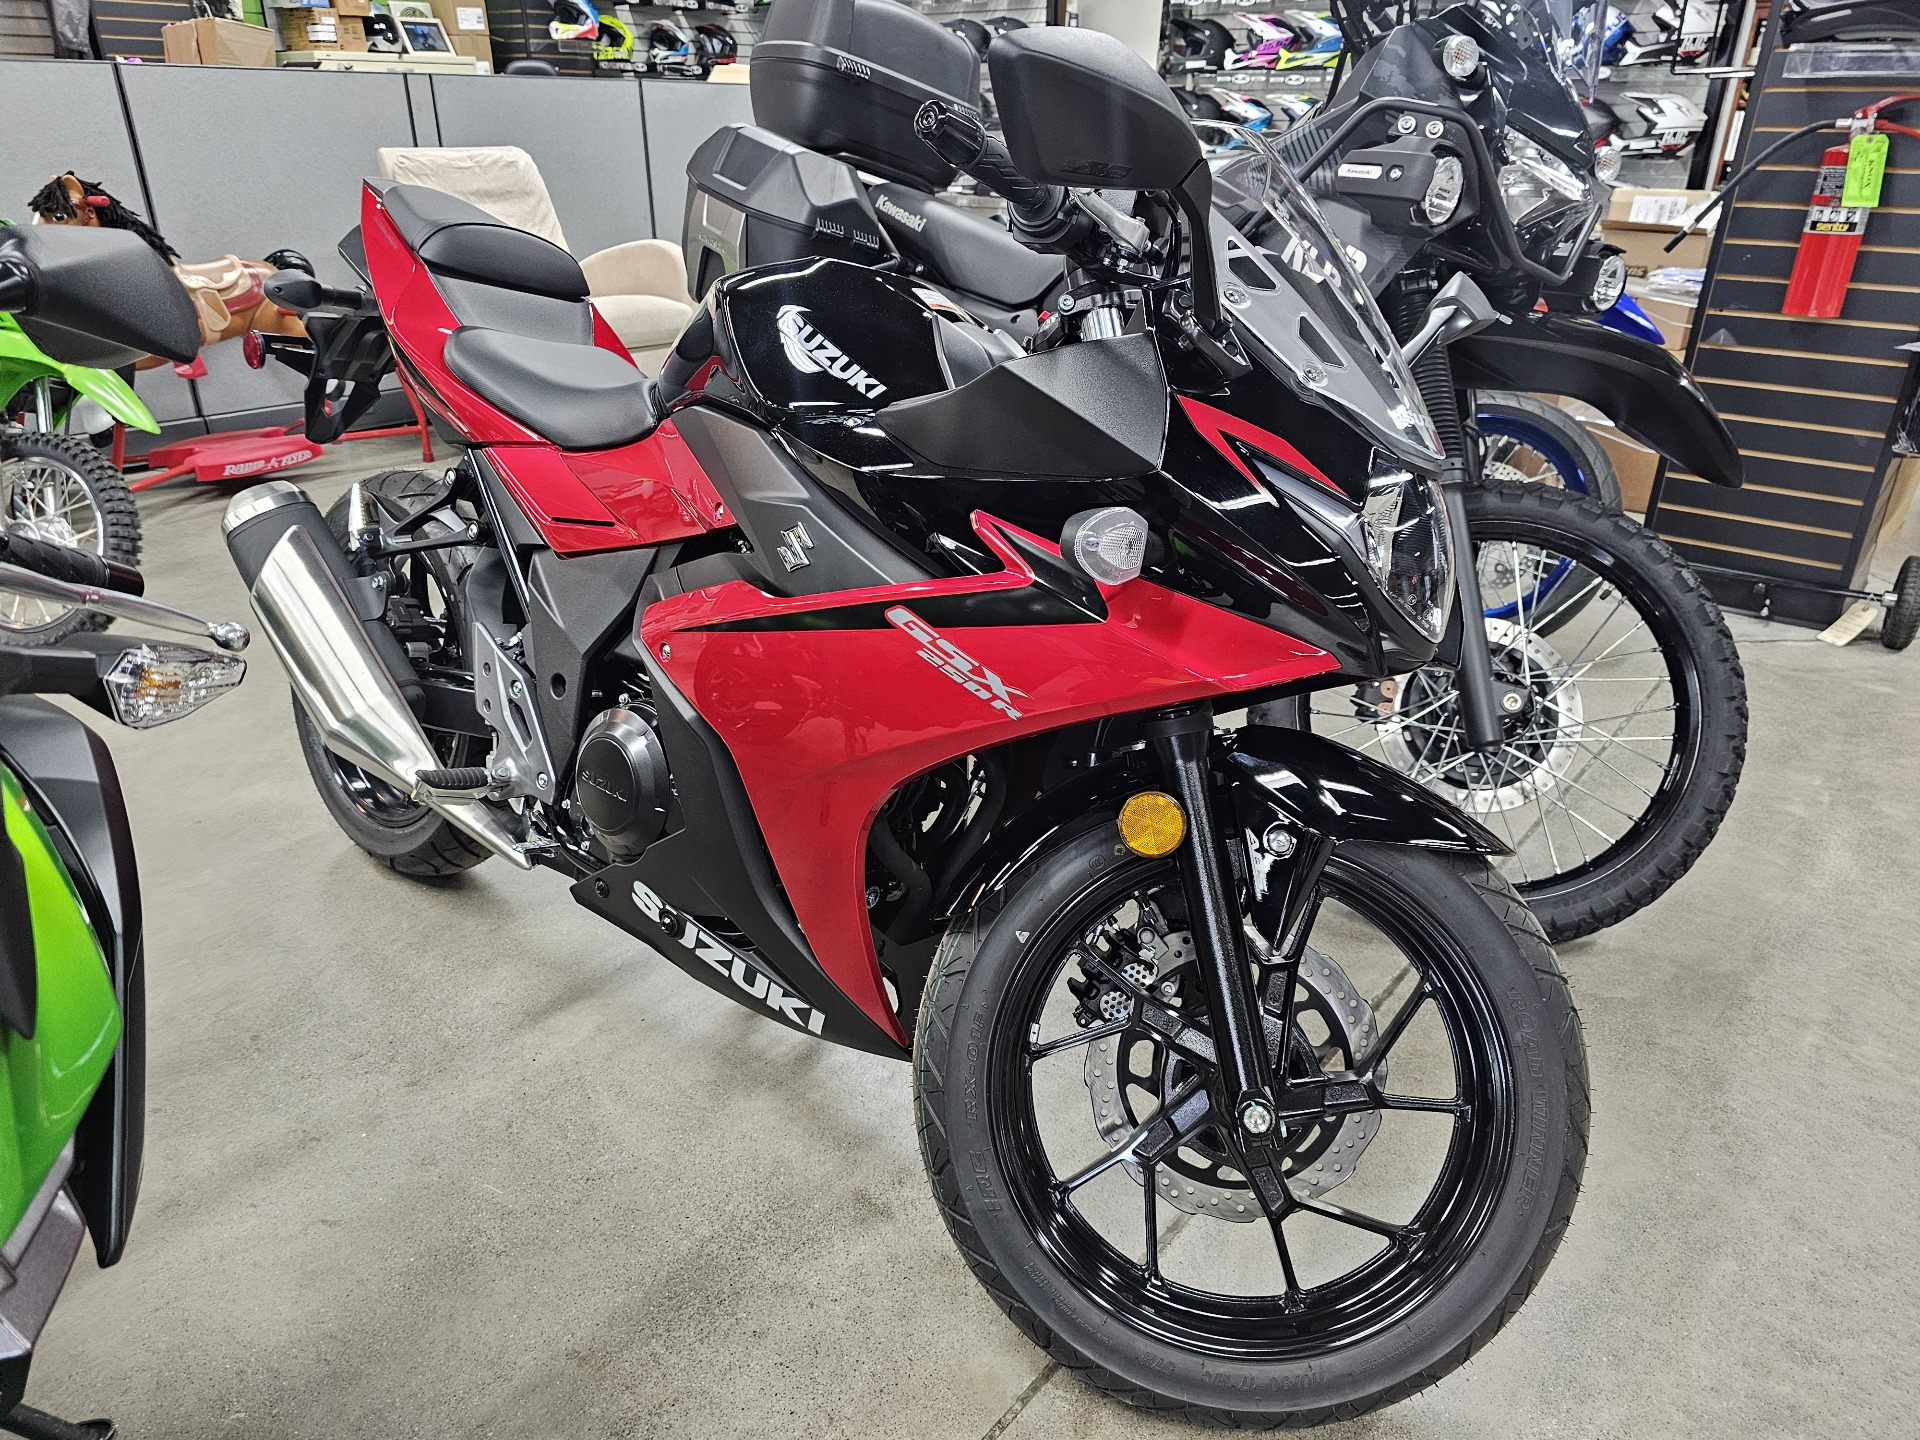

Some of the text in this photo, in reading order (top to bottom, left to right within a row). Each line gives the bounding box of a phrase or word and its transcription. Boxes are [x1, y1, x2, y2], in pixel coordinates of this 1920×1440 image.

[875, 194, 926, 232] Kawasaki
[780, 311, 889, 399] SUZUKI
[887, 607, 1030, 704] GSX
[916, 648, 1023, 721] 250R
[582, 770, 627, 802] SUZUKI
[631, 880, 826, 1035] SUZUKI
[964, 1012, 985, 1121] RX-01F
[1506, 991, 1547, 1211] ROAD WINNER
